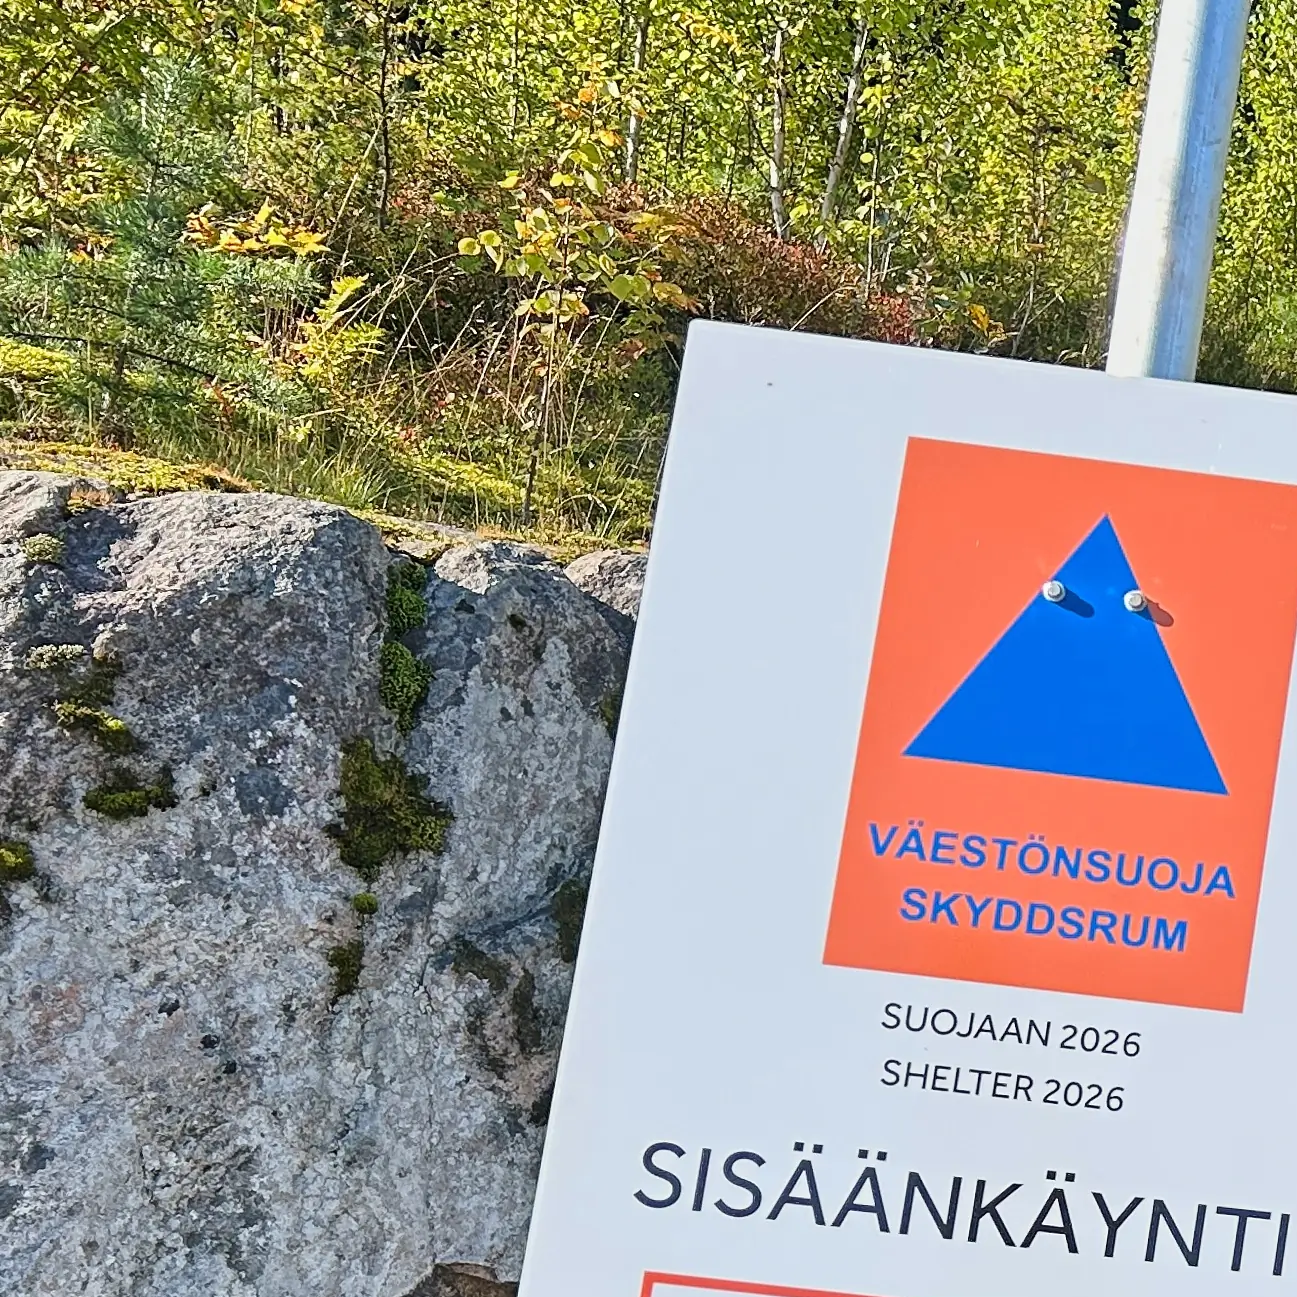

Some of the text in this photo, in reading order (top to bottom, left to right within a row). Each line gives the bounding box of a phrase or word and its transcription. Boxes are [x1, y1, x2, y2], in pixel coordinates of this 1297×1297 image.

[868, 819, 1236, 899] VÄESTÖNSUOJA
[898, 886, 1190, 953] SKYDDSRUM
[880, 1001, 1142, 1058] SUOJAAN 2026
[879, 1058, 1126, 1113] SHELTER 2026
[632, 1140, 1292, 1278] SISÄÄNKÄYNTI
